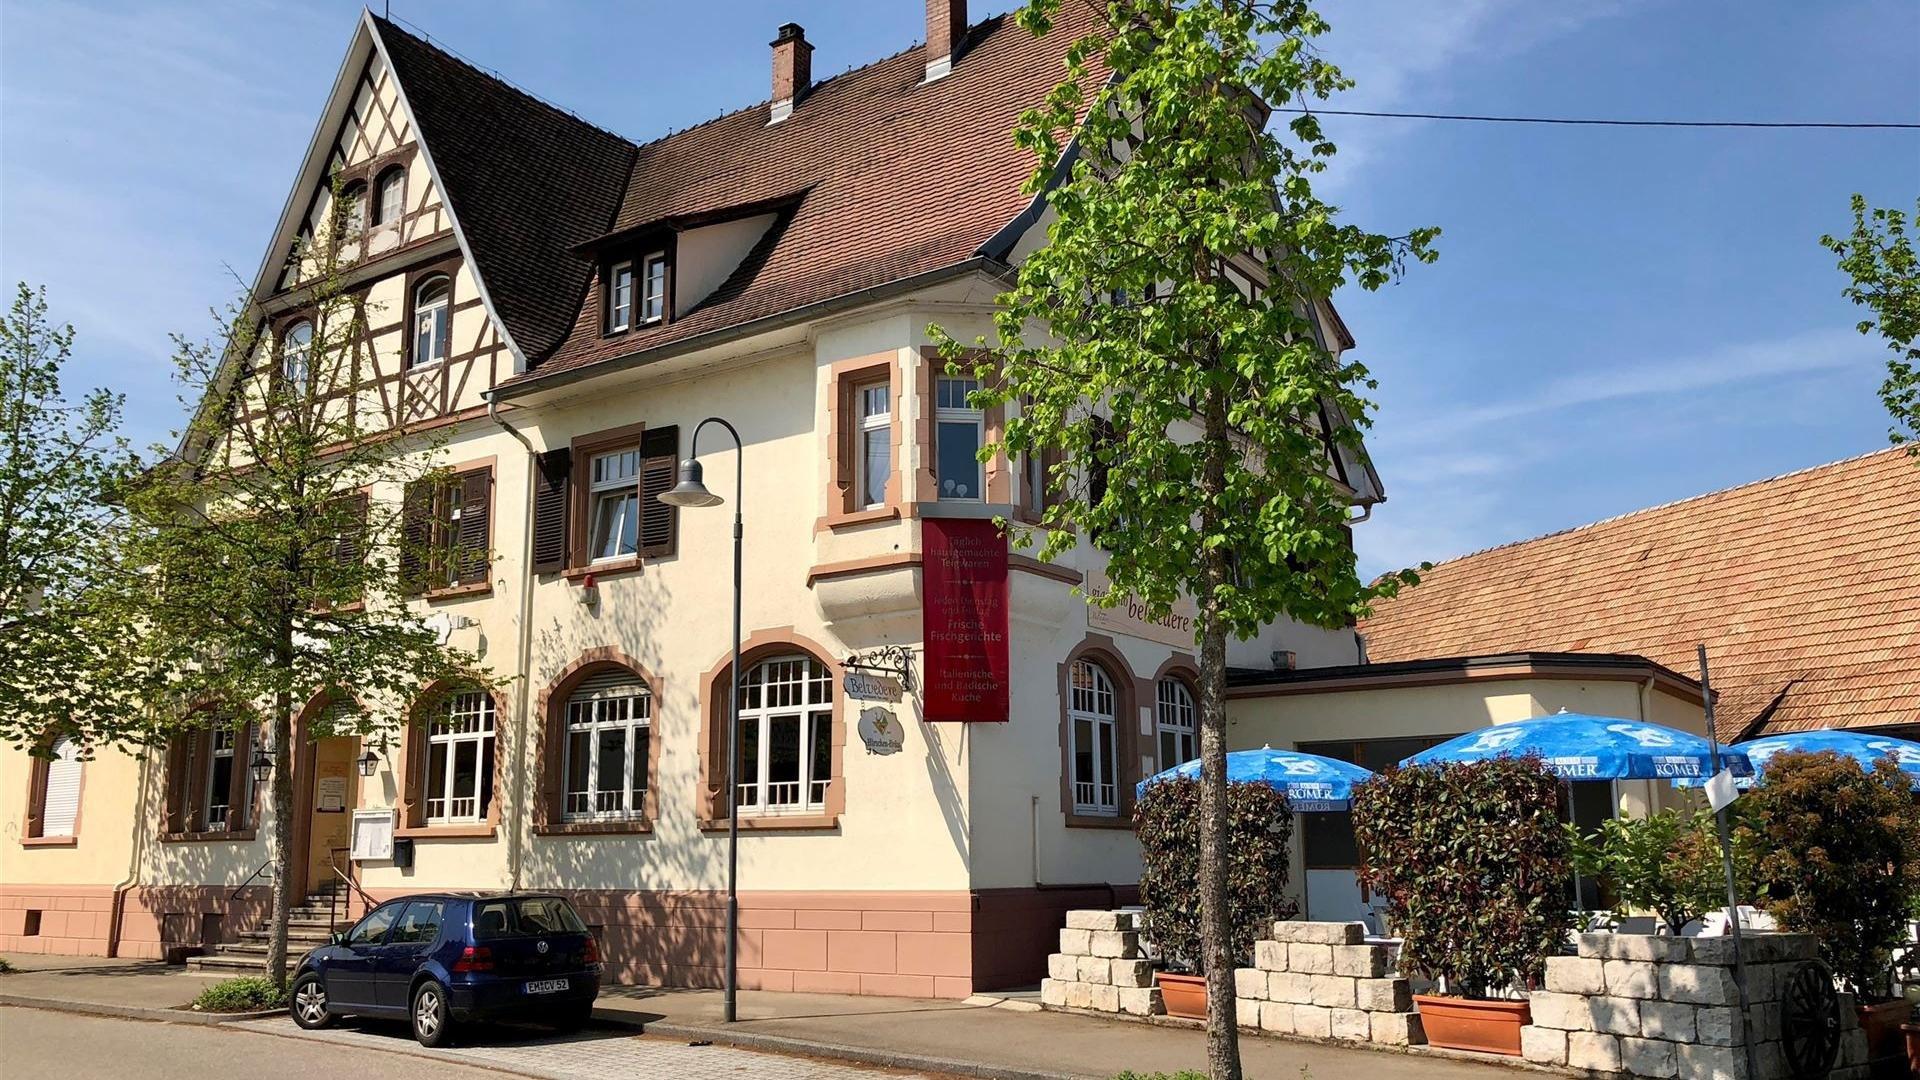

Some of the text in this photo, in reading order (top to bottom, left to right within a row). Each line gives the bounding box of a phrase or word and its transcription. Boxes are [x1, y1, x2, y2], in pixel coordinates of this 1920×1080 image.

[930, 547, 1000, 559] hausgemachte
[1128, 593, 1190, 632] beledere
[948, 619, 985, 630] Frische
[930, 630, 1002, 643] Fischgerichte
[850, 676, 897, 697] Belvedere
[935, 680, 953, 690] und
[528, 980, 568, 992] EM CV 52
